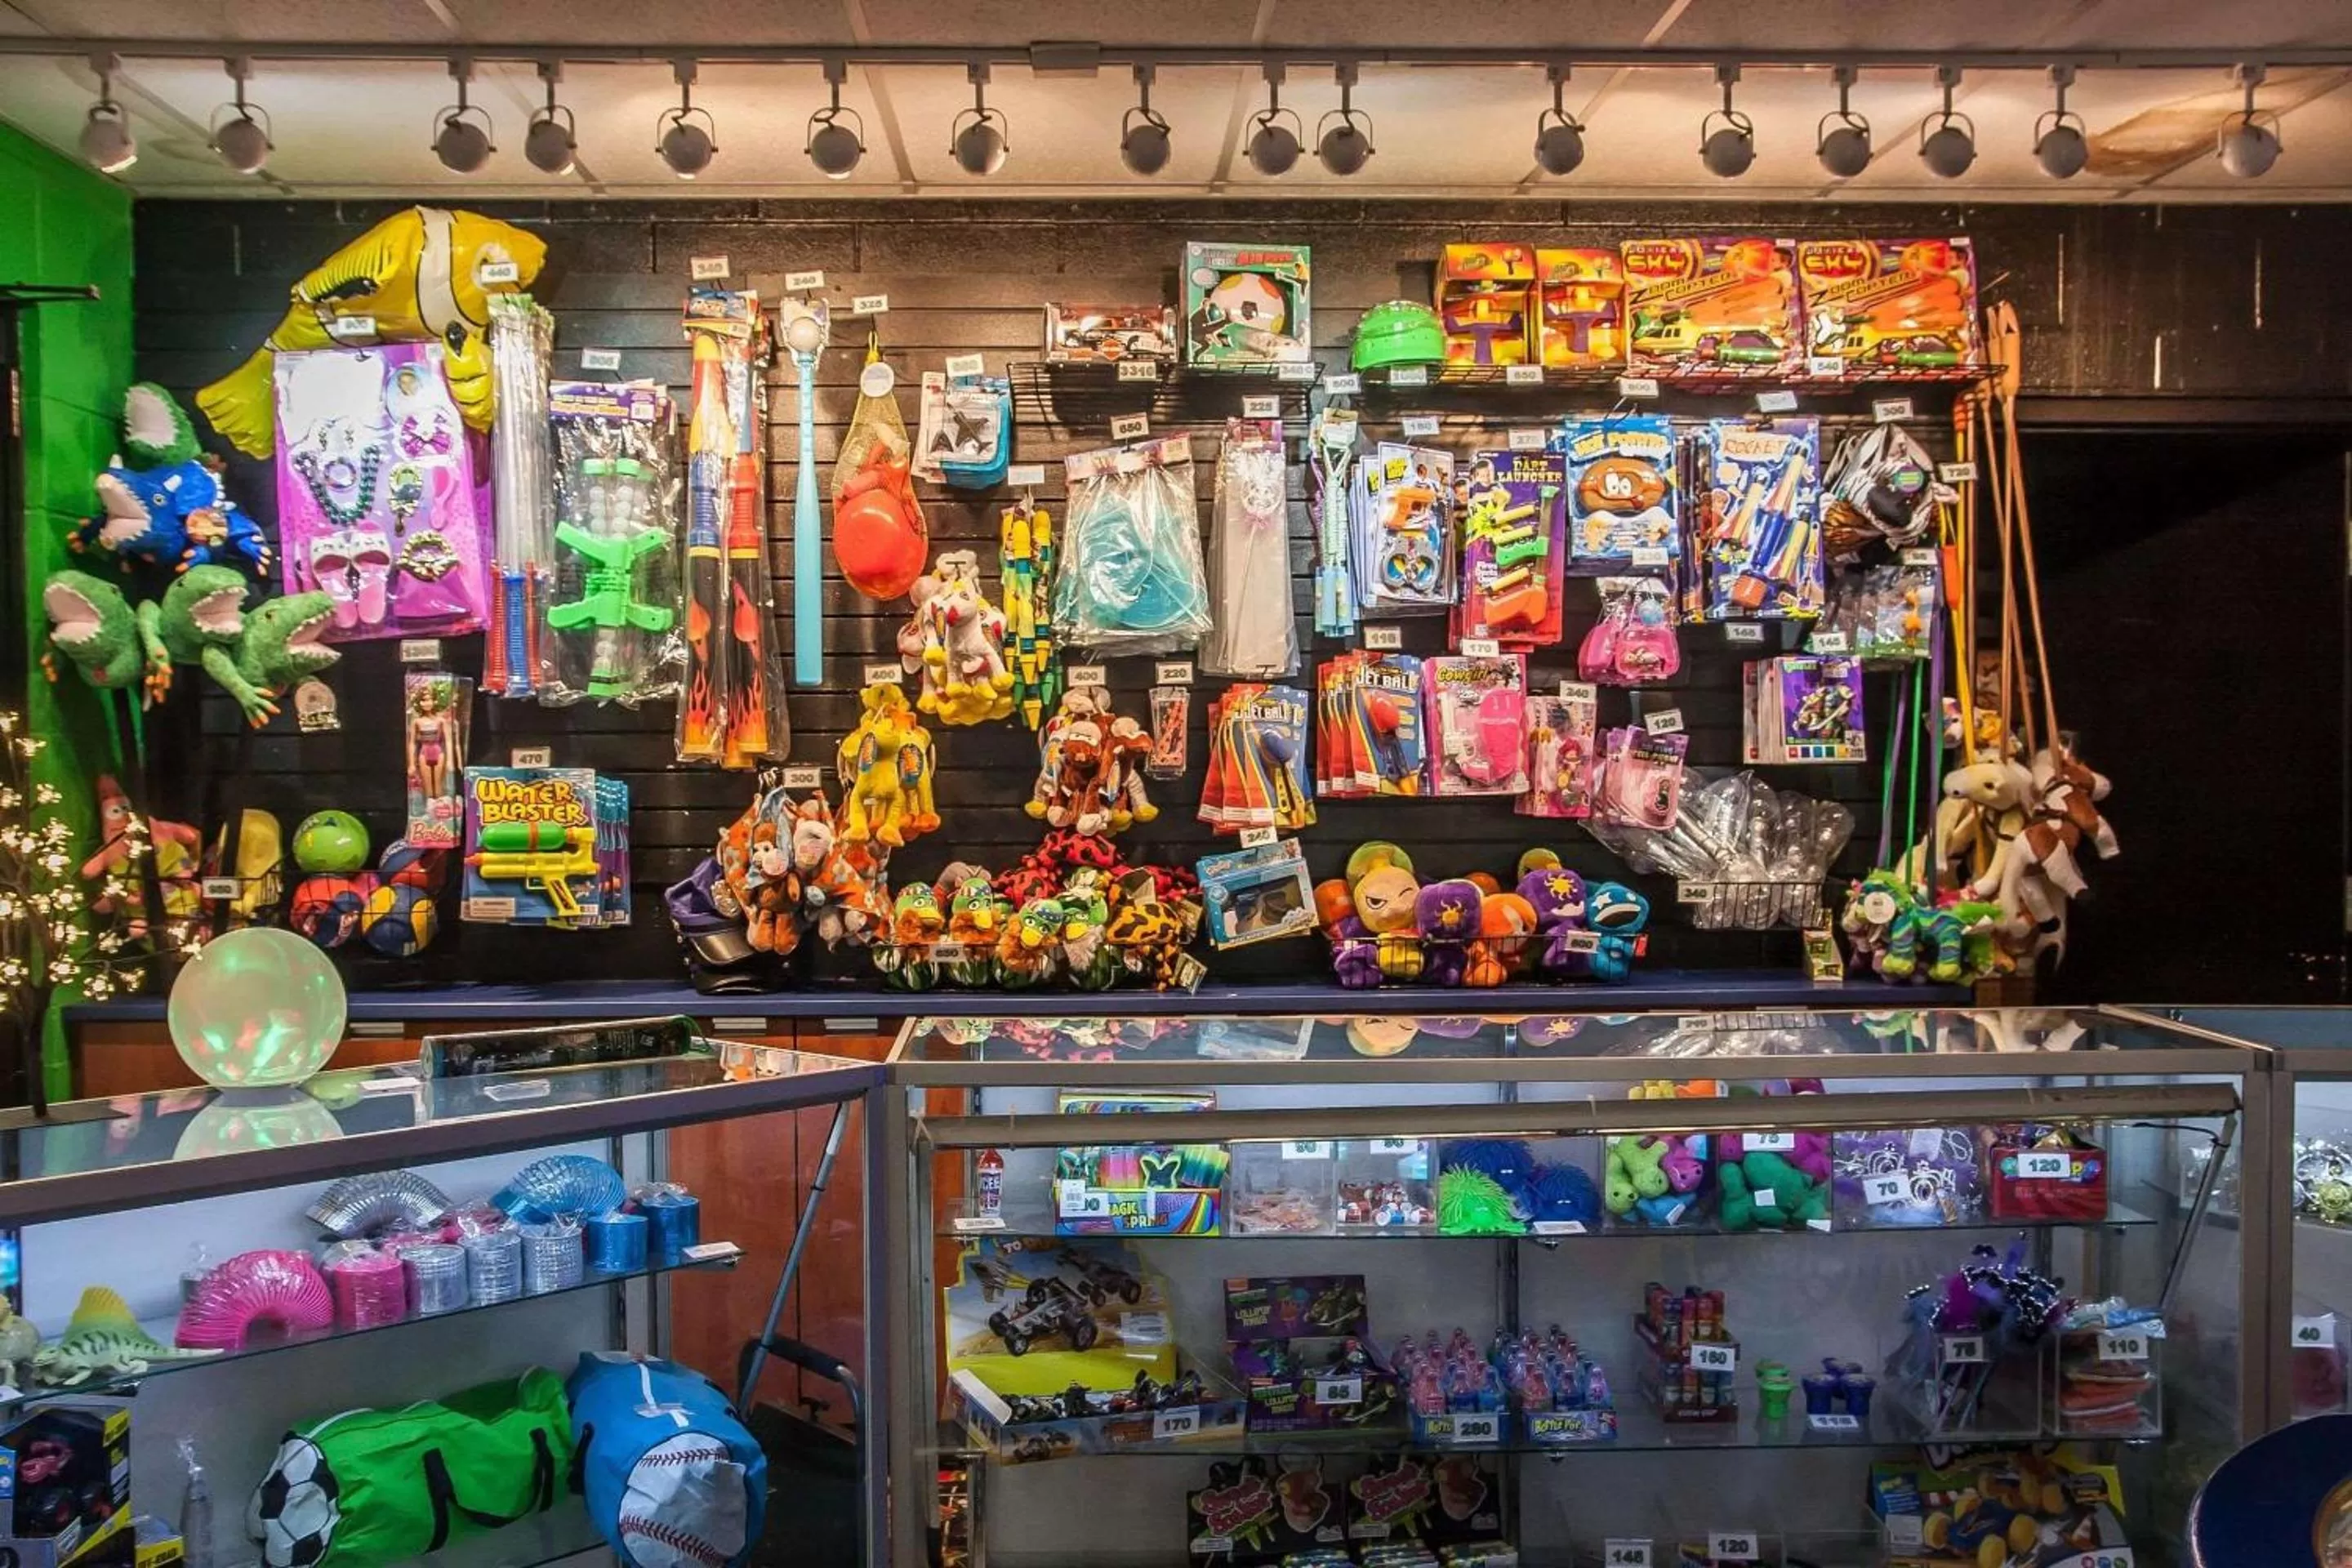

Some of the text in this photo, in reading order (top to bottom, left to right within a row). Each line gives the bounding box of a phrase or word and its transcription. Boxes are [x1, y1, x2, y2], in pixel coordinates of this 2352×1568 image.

[1118, 422, 1142, 434] 650
[1512, 457, 1549, 472] DART
[1356, 665, 1419, 692] JET BALL
[1437, 666, 1492, 684] Cowgirl
[1654, 717, 1677, 729] 120
[519, 752, 542, 764] 470
[790, 773, 813, 783] 300
[475, 777, 573, 804] WATER
[482, 802, 586, 823] BLASTER
[2028, 1159, 2061, 1172] 120
[1877, 1181, 1899, 1196] 70
[2298, 1327, 2321, 1341] 40
[2107, 1339, 2140, 1354] 110
[1162, 1417, 1192, 1432] 170
[1717, 1539, 1749, 1553] 120
